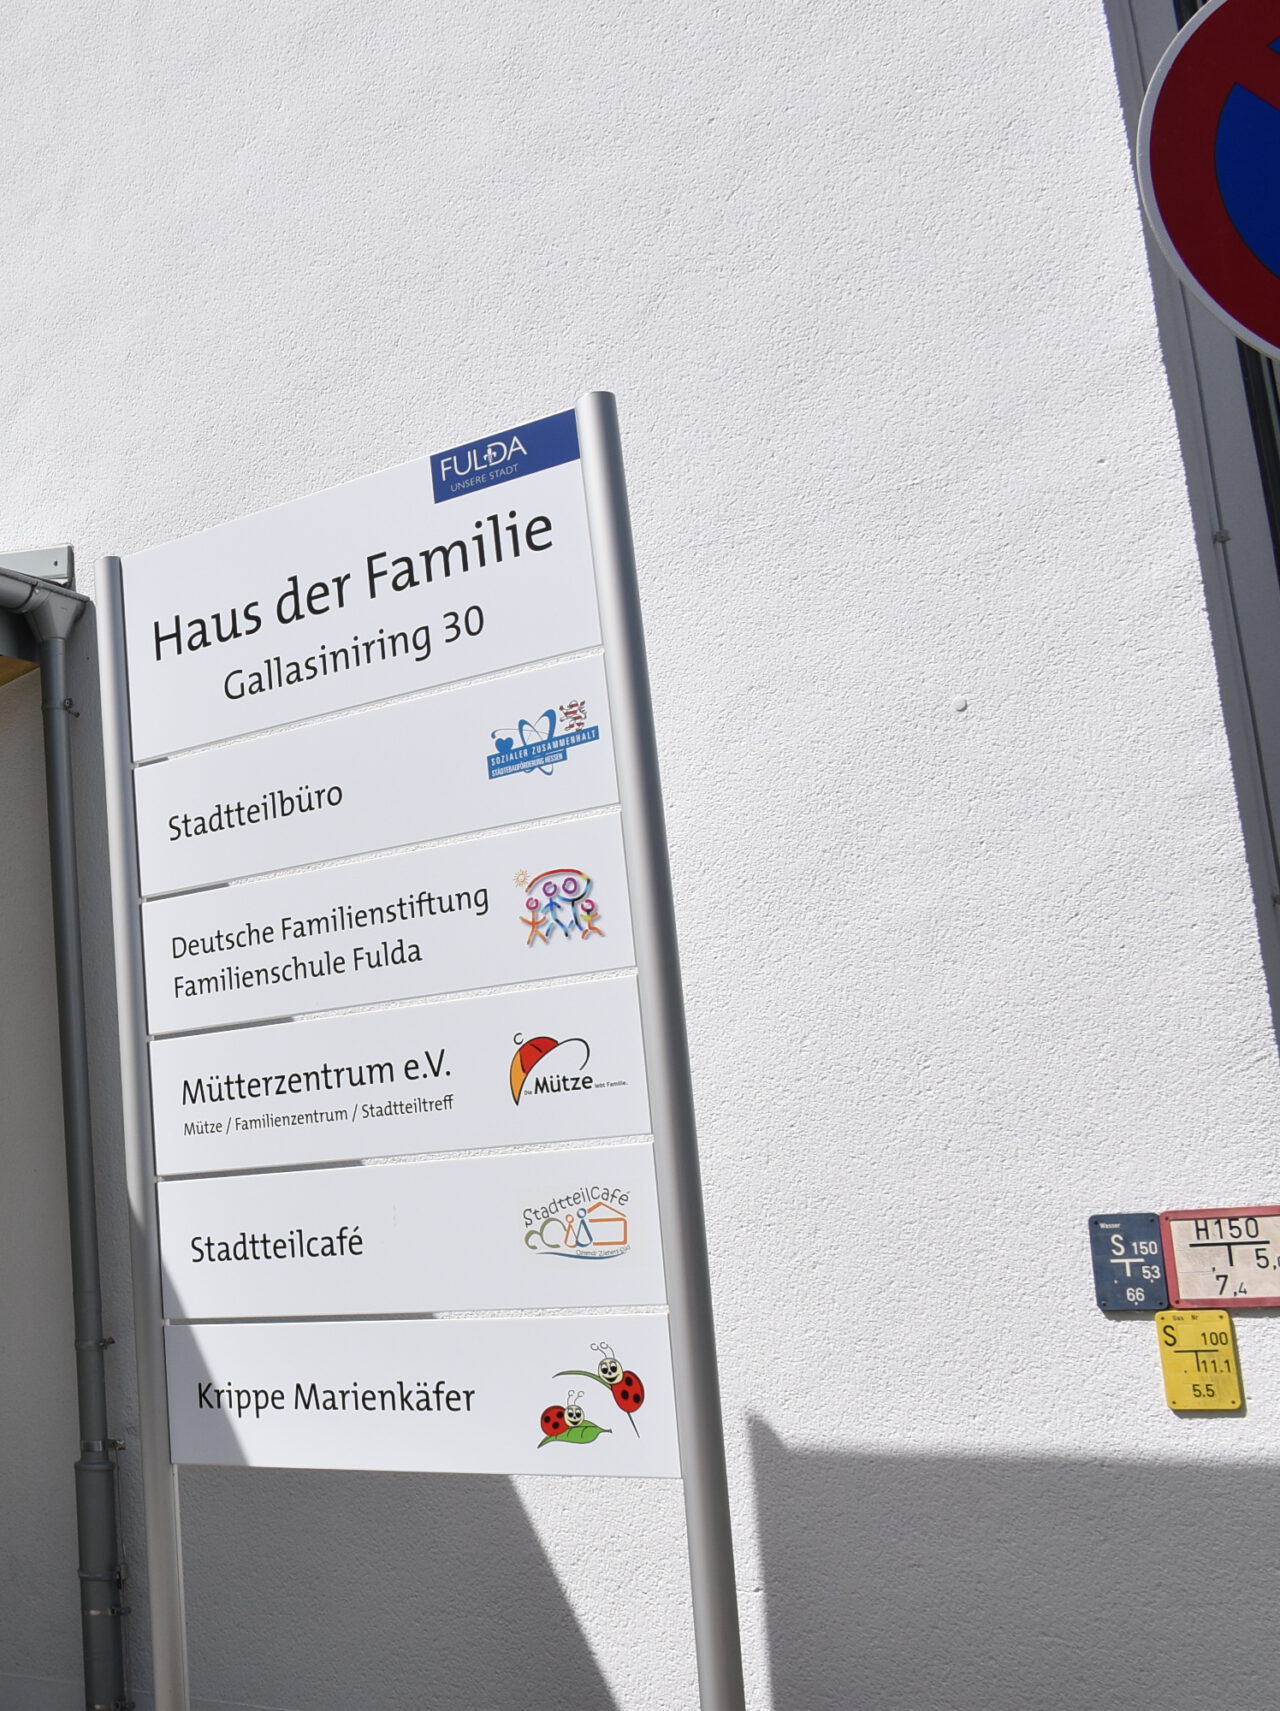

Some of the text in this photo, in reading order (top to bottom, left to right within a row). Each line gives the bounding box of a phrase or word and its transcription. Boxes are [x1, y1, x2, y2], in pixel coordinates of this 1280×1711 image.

[440, 435, 527, 481] FULDA
[451, 464, 519, 492] UNSERE STADT
[153, 510, 553, 661] Haus der Familie
[224, 605, 484, 700] Gallasiniring 30
[491, 729, 597, 767] SOZIALER ZUSAMMENHALT
[168, 785, 343, 841] Stadtteilbüro
[172, 888, 489, 959] Deutsche Familienstiftung
[174, 939, 423, 999] Familienschule Fulda
[182, 1049, 452, 1106] Mütterzentrum e.V.
[534, 1074, 594, 1095] Mütze
[183, 1117, 223, 1136] Mütze
[234, 1107, 349, 1132] Familienzentrum
[361, 1094, 454, 1119] Stadtteiltreff
[191, 1225, 364, 1263] Stadtteilcafé
[1110, 1234, 1158, 1256] S 150
[1215, 1274, 1248, 1297] 7,4
[1162, 1325, 1229, 1347] S 100
[197, 1380, 476, 1419] Krippe Marienkäfer
[1192, 1384, 1215, 1398] 5.5
